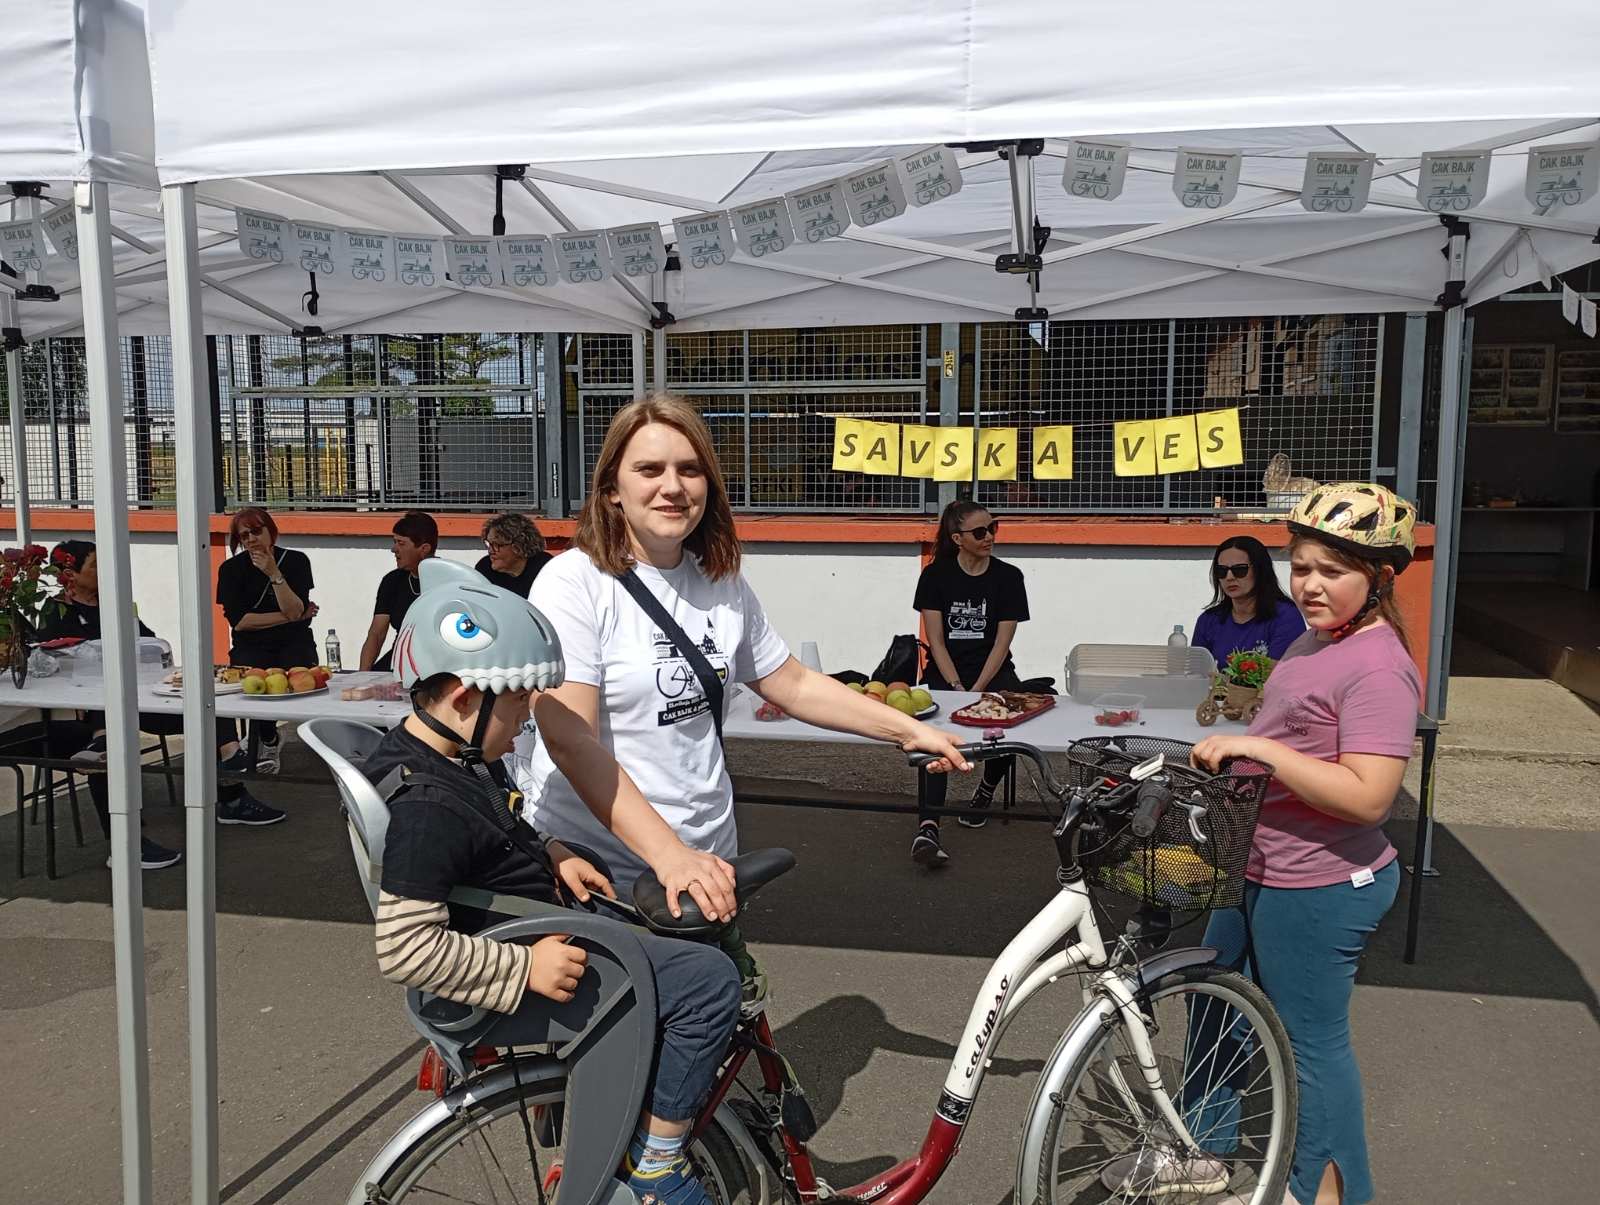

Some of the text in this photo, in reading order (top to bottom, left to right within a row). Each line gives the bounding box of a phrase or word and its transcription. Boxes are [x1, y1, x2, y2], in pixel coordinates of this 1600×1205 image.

[923, 152, 943, 167] BAJK
[1095, 148, 1115, 161] BAJK
[1560, 154, 1584, 167] BAJK
[1205, 159, 1227, 171] BAJK
[1336, 163, 1359, 176] BAJK
[1452, 161, 1475, 174] BAJK
[868, 173, 887, 188] BAJK
[813, 192, 832, 206] BAJK
[758, 208, 777, 221] BAJK
[700, 221, 719, 233] BAJK
[633, 233, 651, 244] BAJK
[839, 426, 1224, 468] SAVSKA VES
[965, 974, 1009, 1079] calypso
